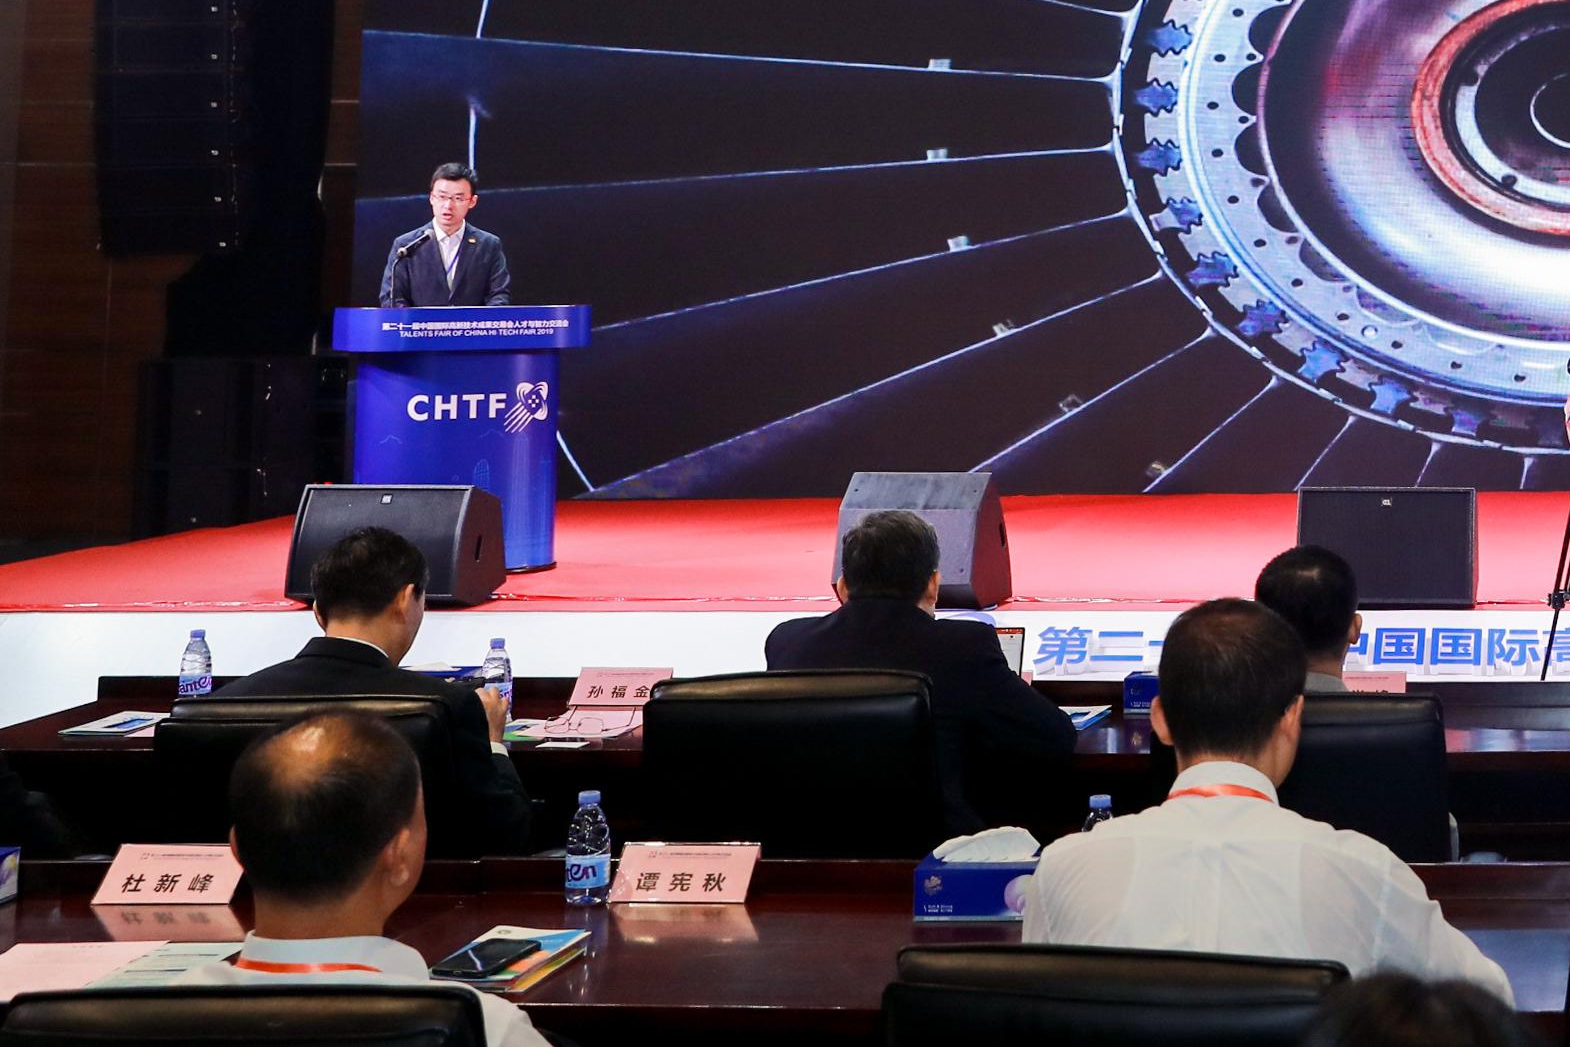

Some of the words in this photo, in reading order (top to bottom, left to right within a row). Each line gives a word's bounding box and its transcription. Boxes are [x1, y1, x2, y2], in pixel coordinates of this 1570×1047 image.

[400, 330, 434, 338] TALENTS
[434, 329, 452, 337] FAIR
[452, 329, 463, 337] OF
[464, 329, 488, 337] CHINA
[519, 328, 537, 336] FAIR
[407, 393, 507, 421] CHTF
[586, 685, 651, 699] 孙福金
[121, 873, 214, 894] 杜新峰
[635, 871, 727, 893] 谭宪秋
